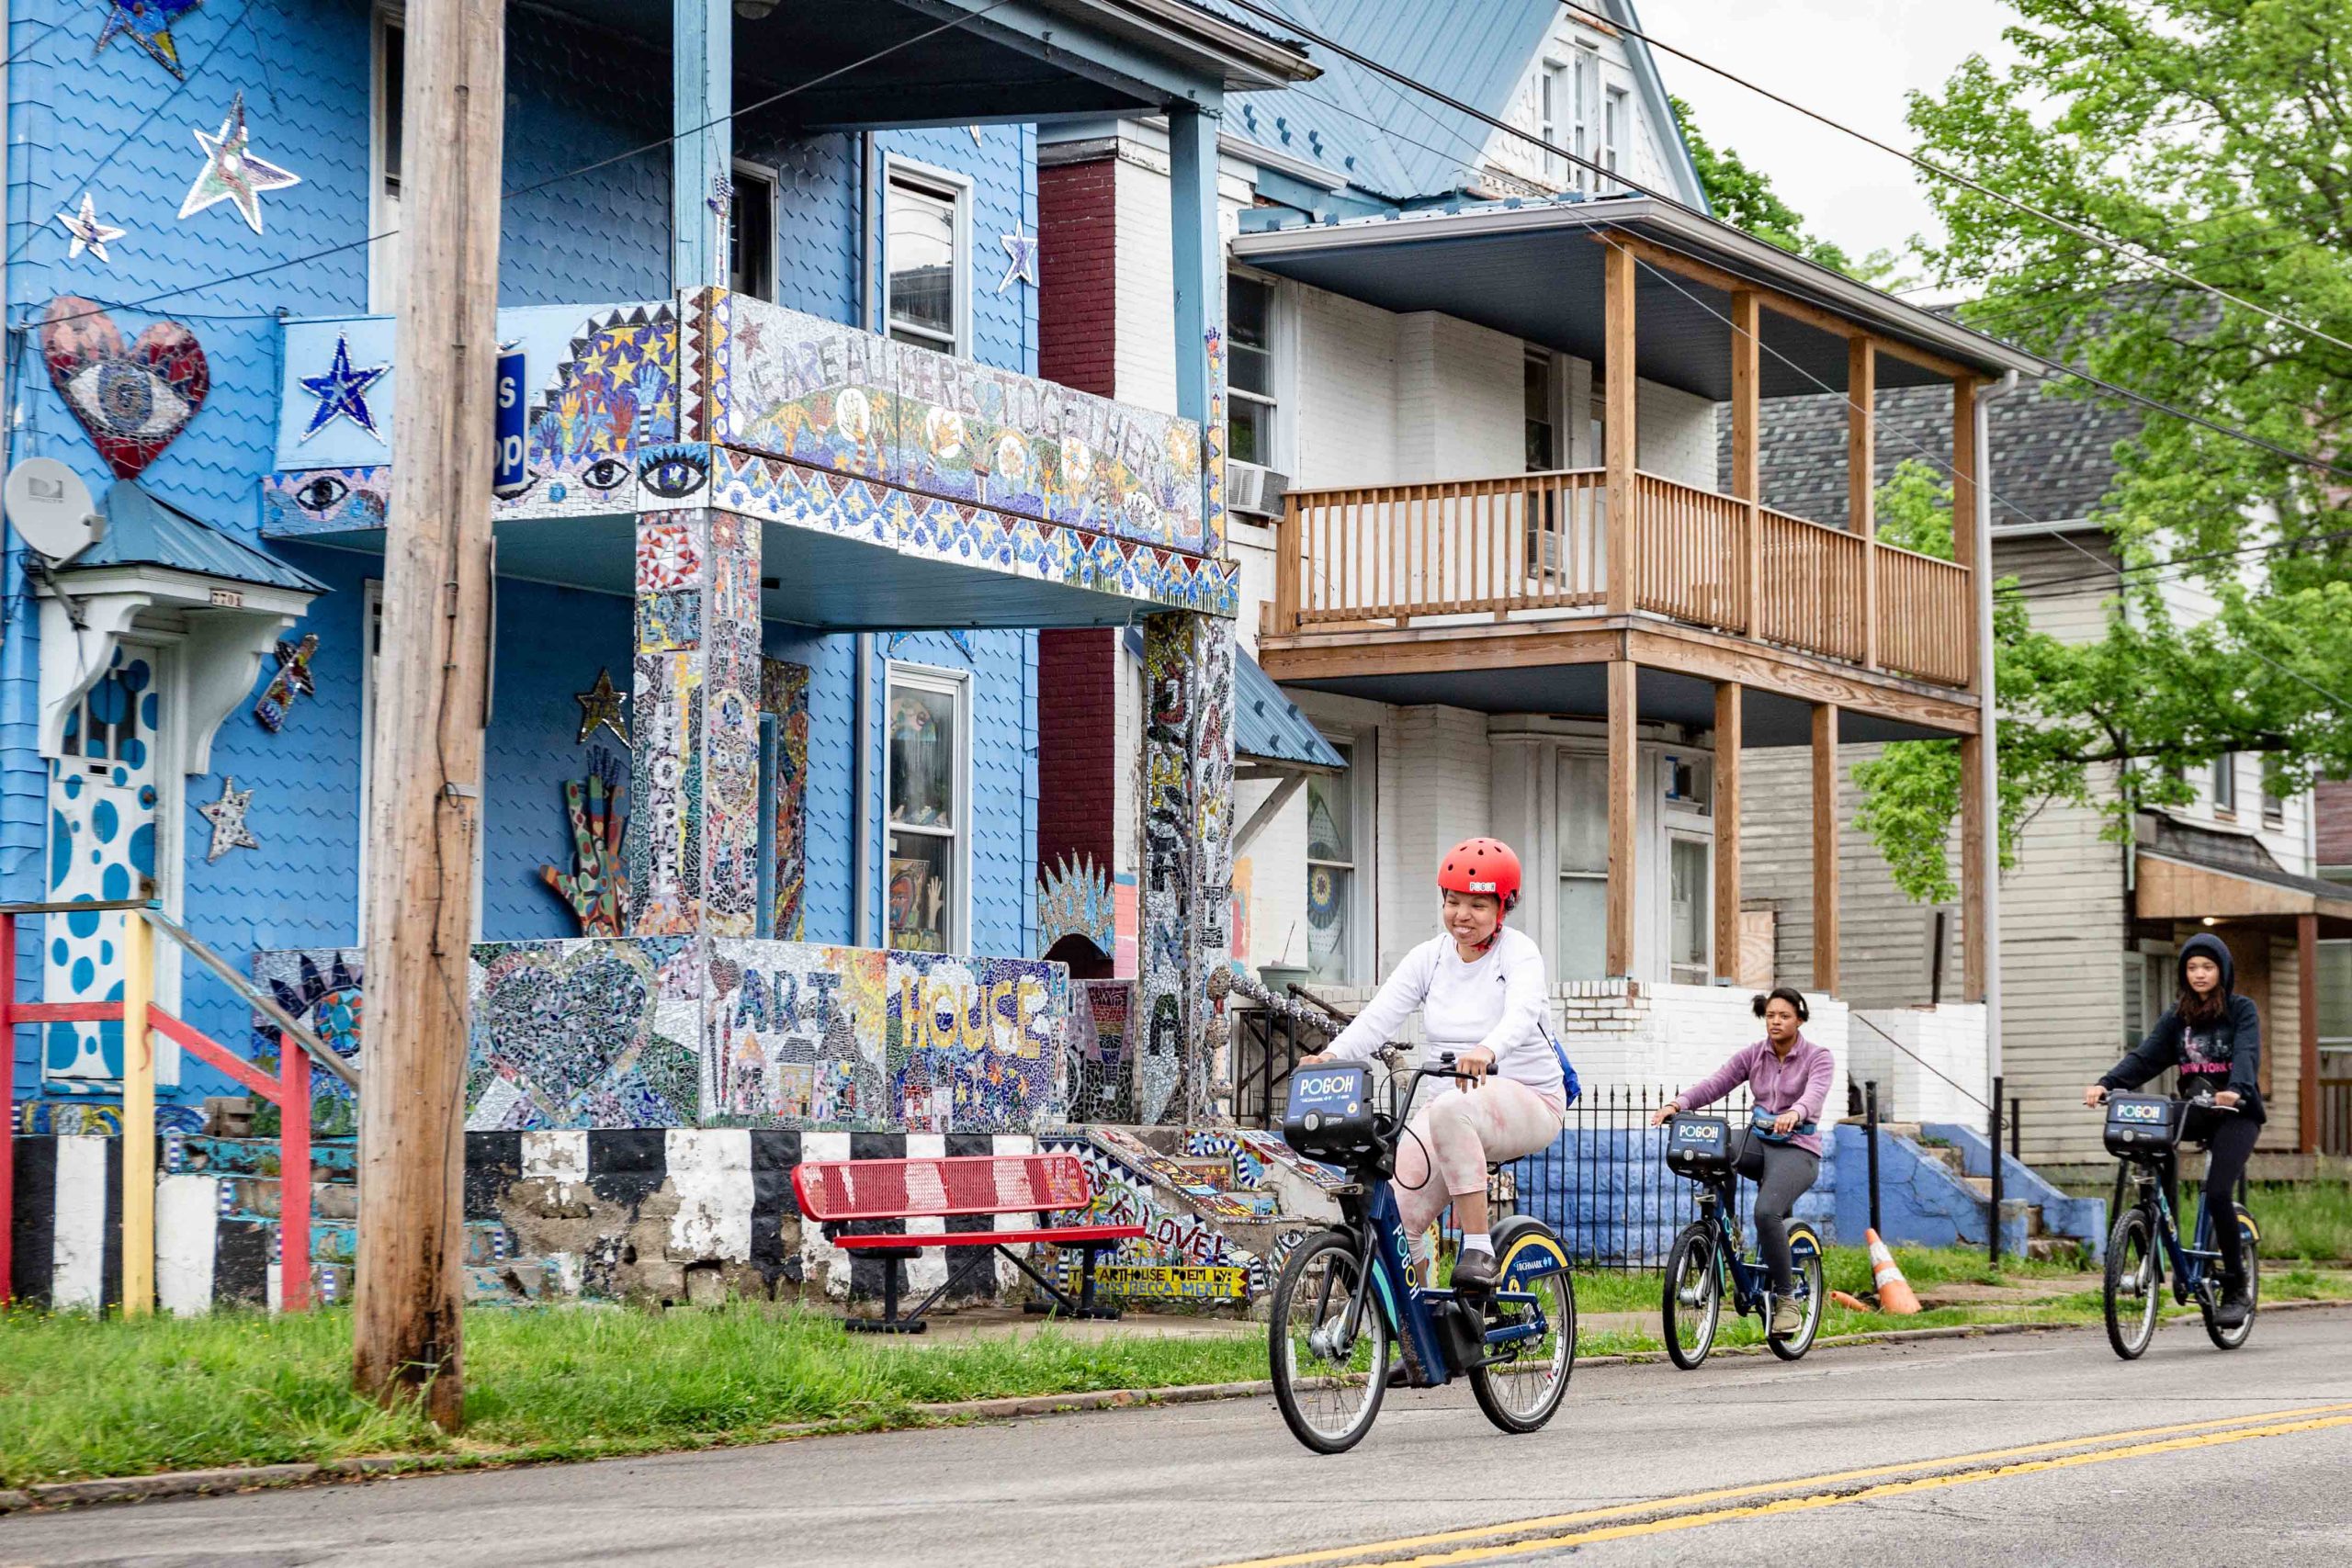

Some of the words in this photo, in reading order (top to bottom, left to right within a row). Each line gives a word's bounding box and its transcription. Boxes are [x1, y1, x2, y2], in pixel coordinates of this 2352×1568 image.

[780, 336, 840, 400] ARE
[899, 347, 977, 415] HERE
[992, 371, 1160, 502] TOGETHER
[735, 969, 841, 1035] ART
[900, 975, 1045, 1058] HOUSE
[2181, 1063, 2199, 1074] NEW
[2202, 1062, 2227, 1073] YORK
[1299, 1076, 1354, 1096] POGOH
[2117, 1104, 2161, 1118] POGOH
[1679, 1125, 1719, 1138] POGOH
[1144, 1204, 1223, 1262] LOVE!
[1393, 1223, 1420, 1301] POGOH
[1516, 1259, 1544, 1271] HIGHMARK
[1171, 1269, 1205, 1281] POEM
